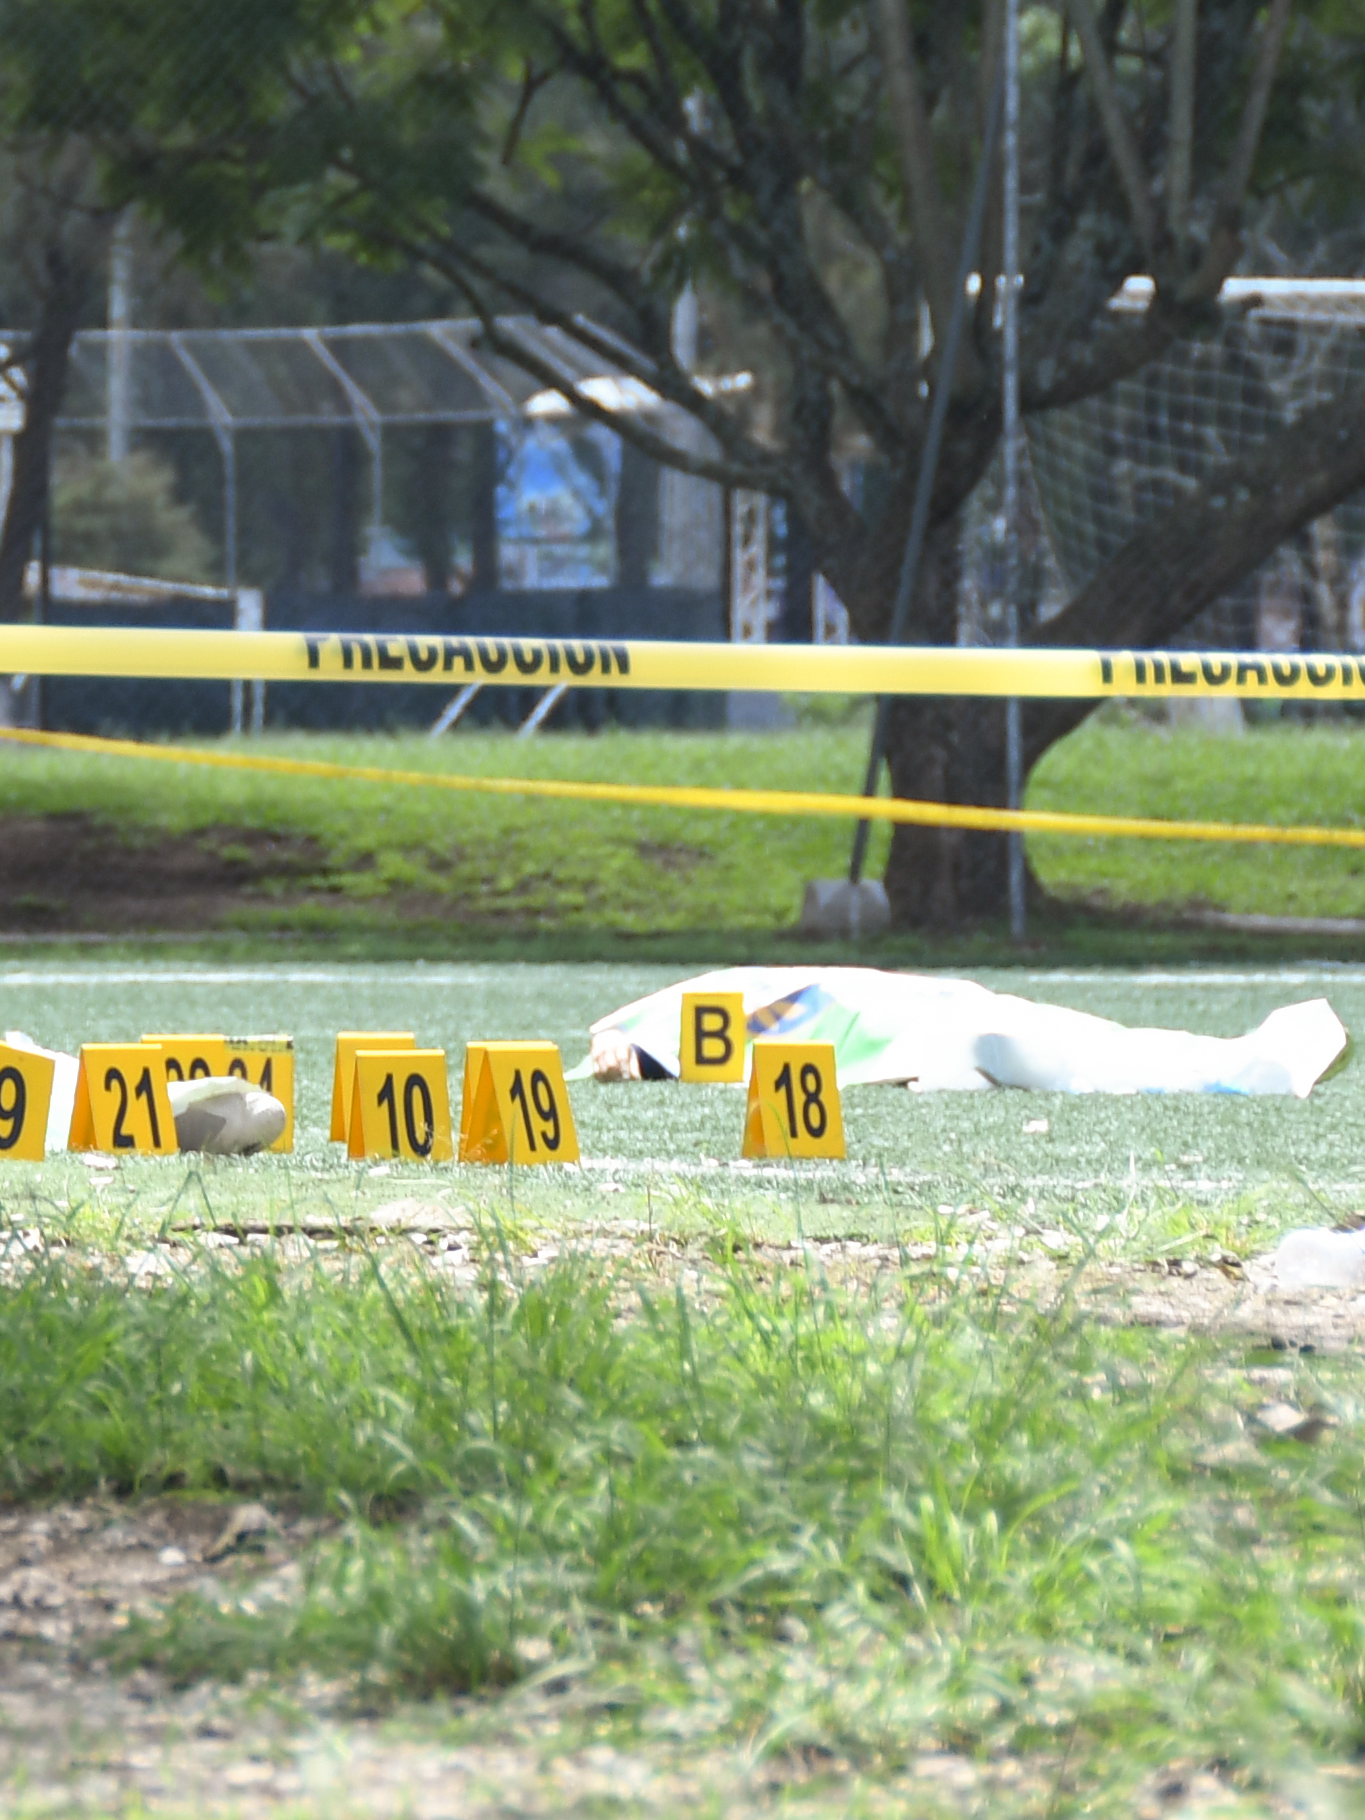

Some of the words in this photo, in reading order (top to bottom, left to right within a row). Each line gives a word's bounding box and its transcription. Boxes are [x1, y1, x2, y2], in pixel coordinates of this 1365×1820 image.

[695, 1006, 732, 1065] B
[104, 1067, 161, 1149] 21
[377, 1073, 434, 1158] 10
[509, 1069, 561, 1152] 19
[774, 1063, 827, 1139] 18
